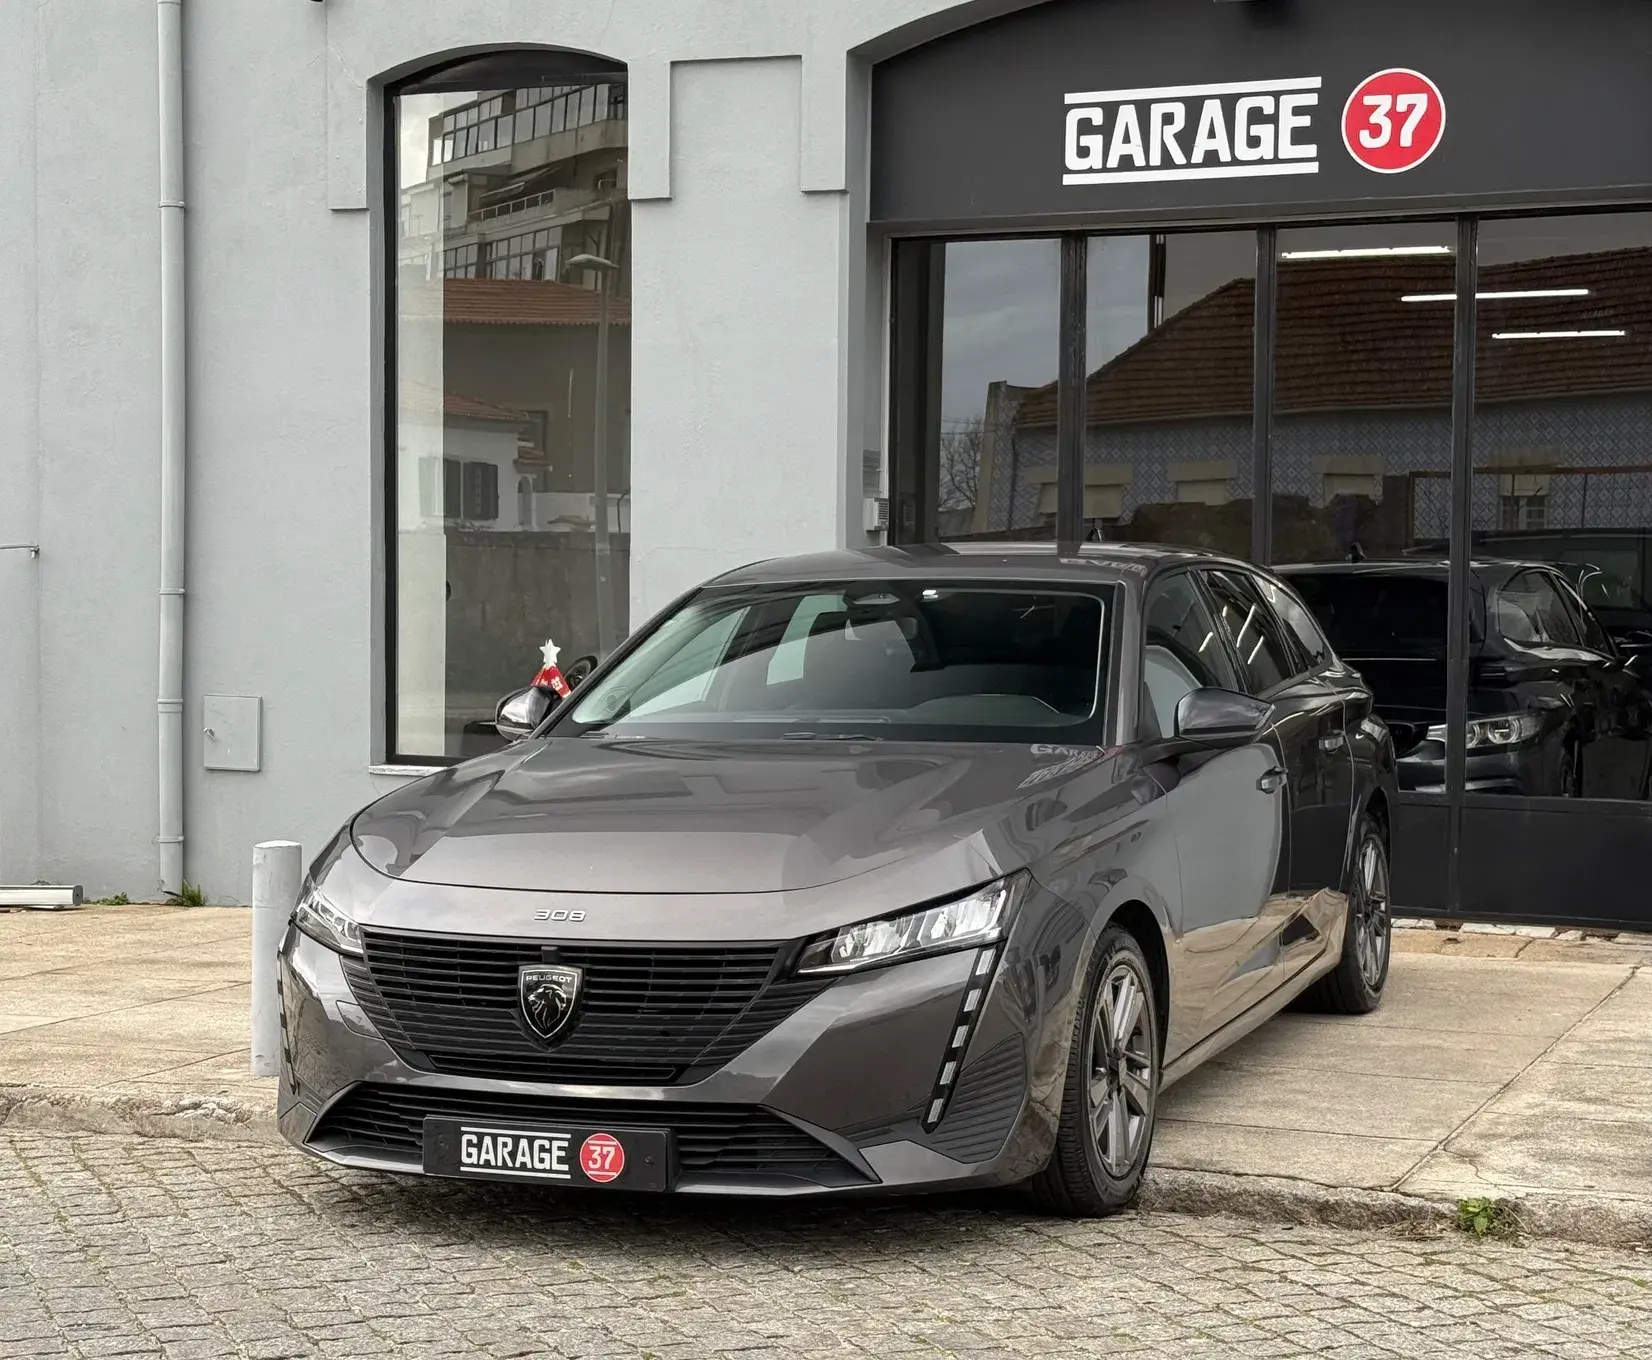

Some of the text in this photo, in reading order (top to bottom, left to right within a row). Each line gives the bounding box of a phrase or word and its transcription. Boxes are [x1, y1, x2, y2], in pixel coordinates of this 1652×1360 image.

[1065, 92, 1428, 171] GARAGE 37
[533, 908, 586, 922] 308
[525, 974, 573, 984] PEUGEOT
[460, 1133, 616, 1172] GARAGE 37
